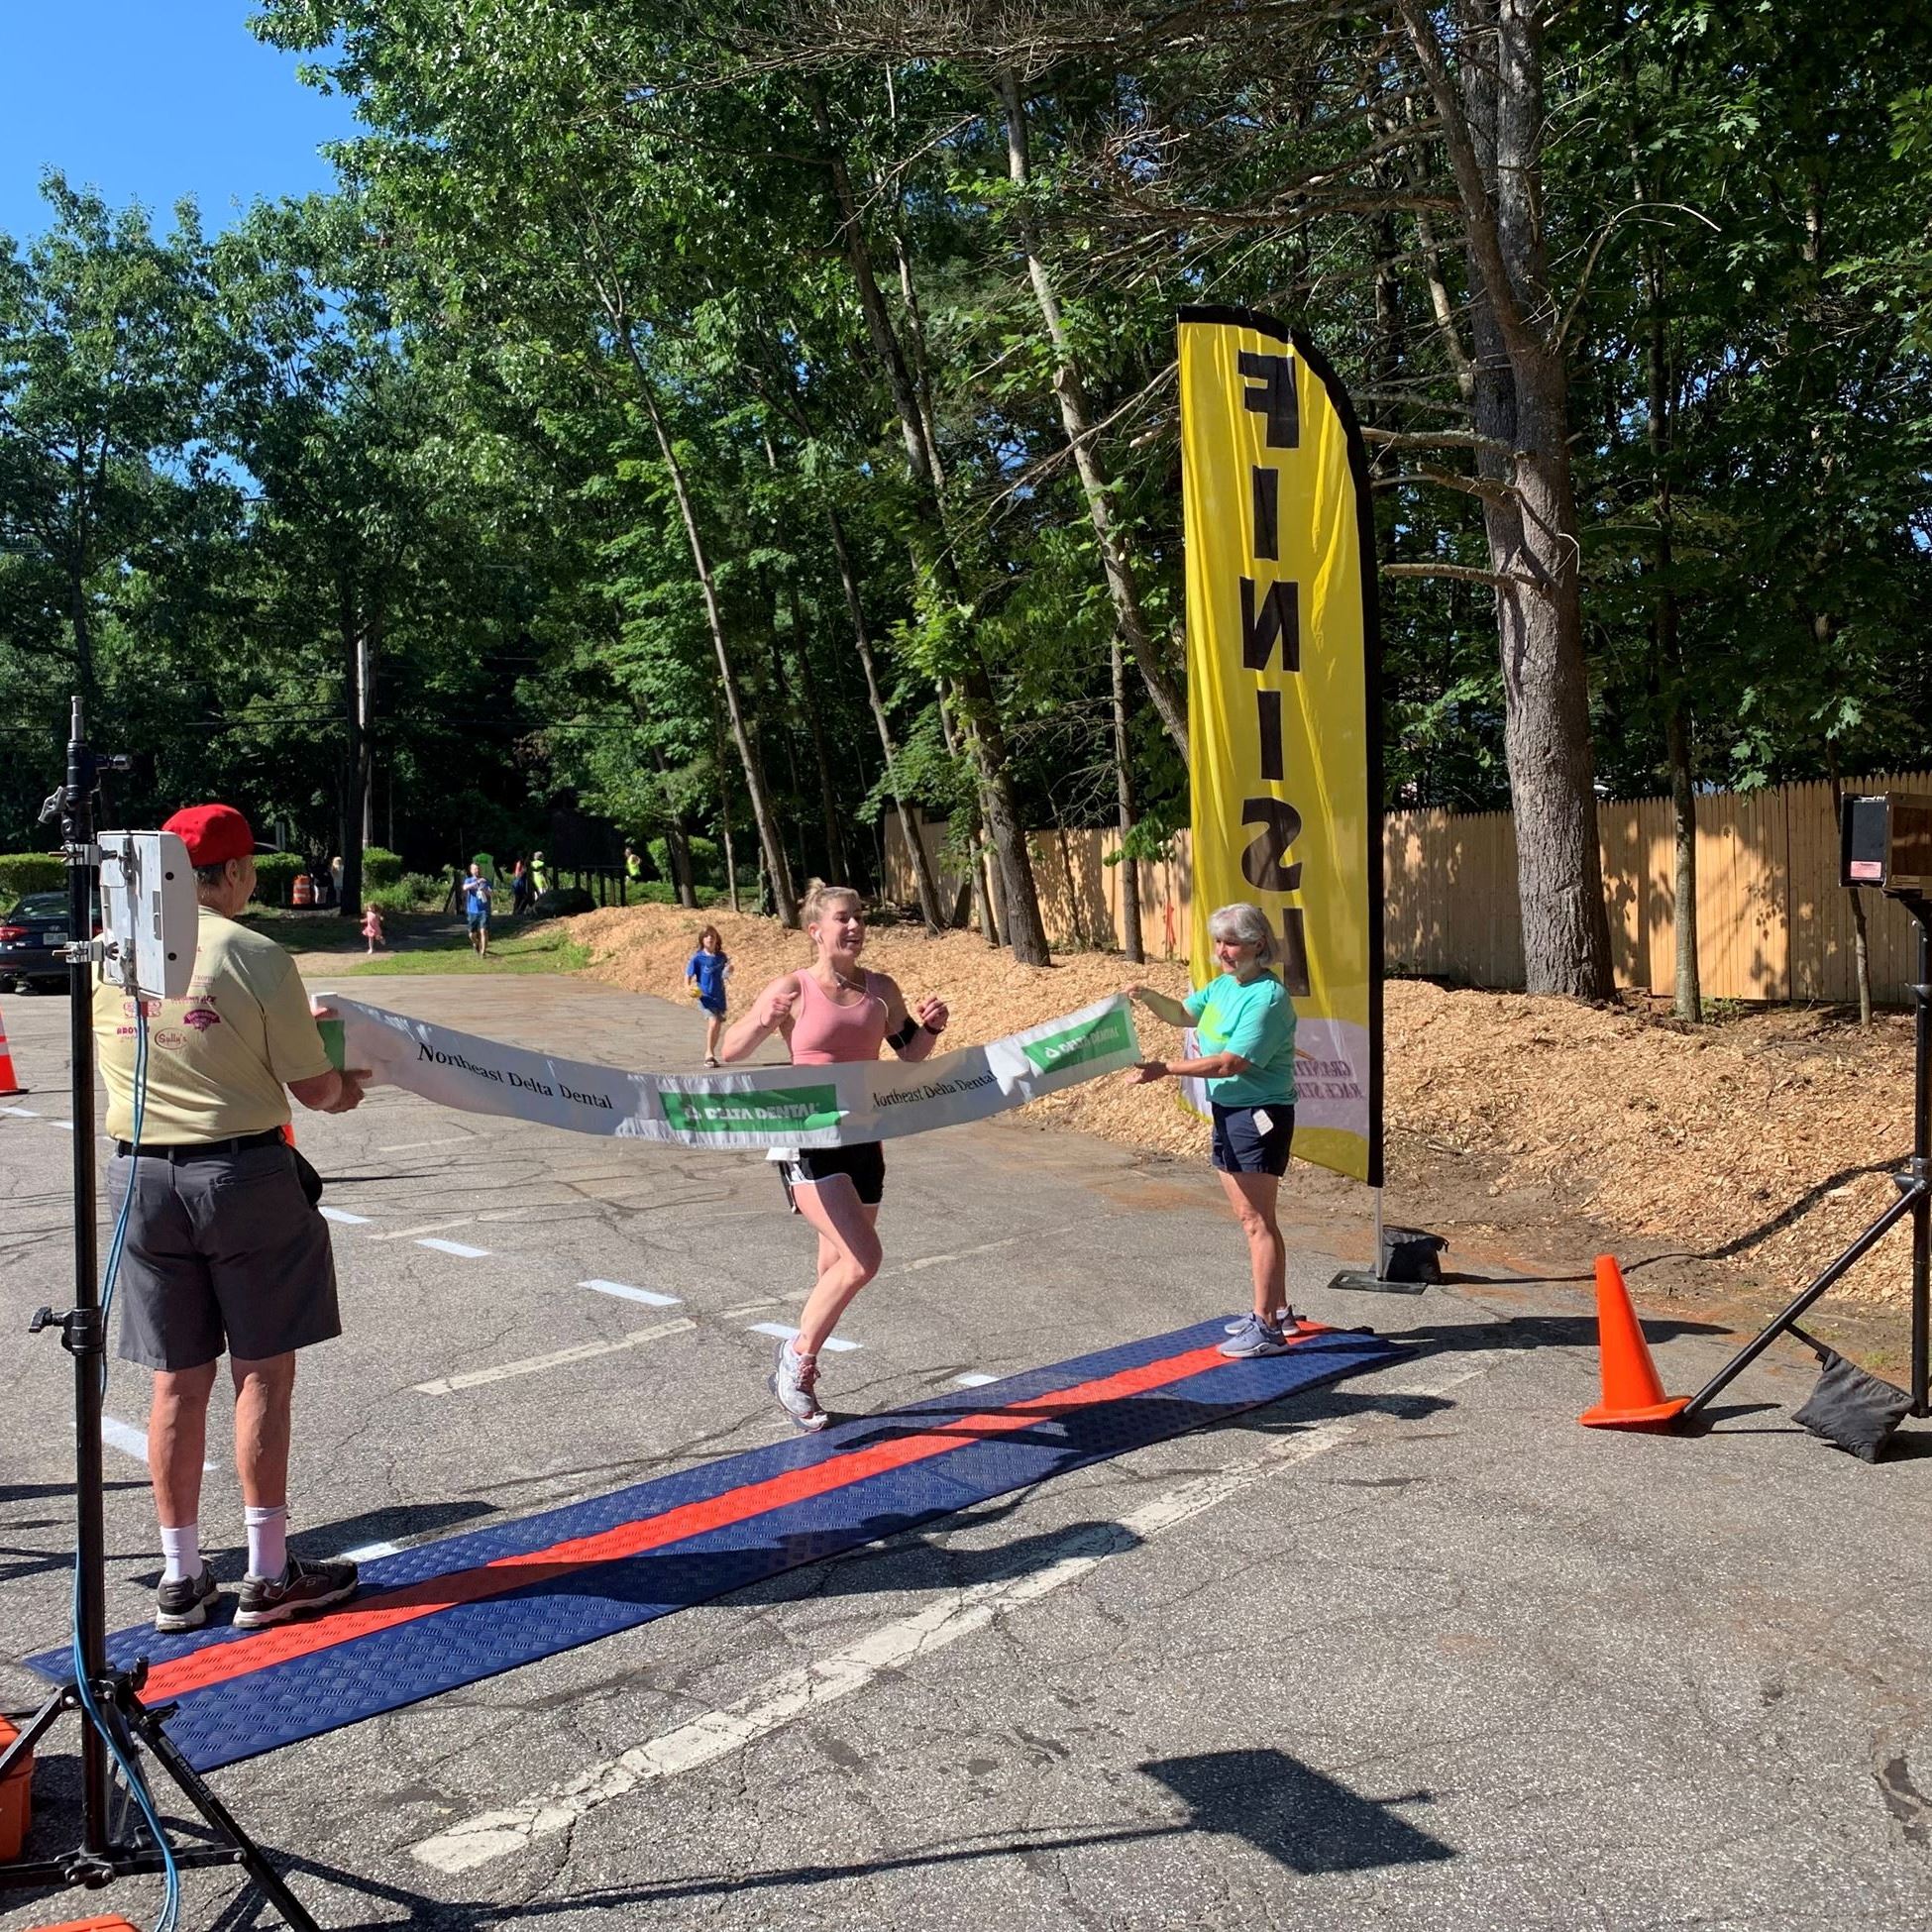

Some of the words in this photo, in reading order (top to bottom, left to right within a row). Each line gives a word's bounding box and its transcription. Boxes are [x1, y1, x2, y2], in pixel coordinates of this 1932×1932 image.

[416, 1041, 504, 1084] Northeast
[507, 1072, 554, 1097] Delta
[558, 1083, 614, 1110] Dental
[923, 1076, 956, 1099] Delta
[958, 1070, 998, 1093] Dental
[754, 1102, 817, 1121] DENTAL
